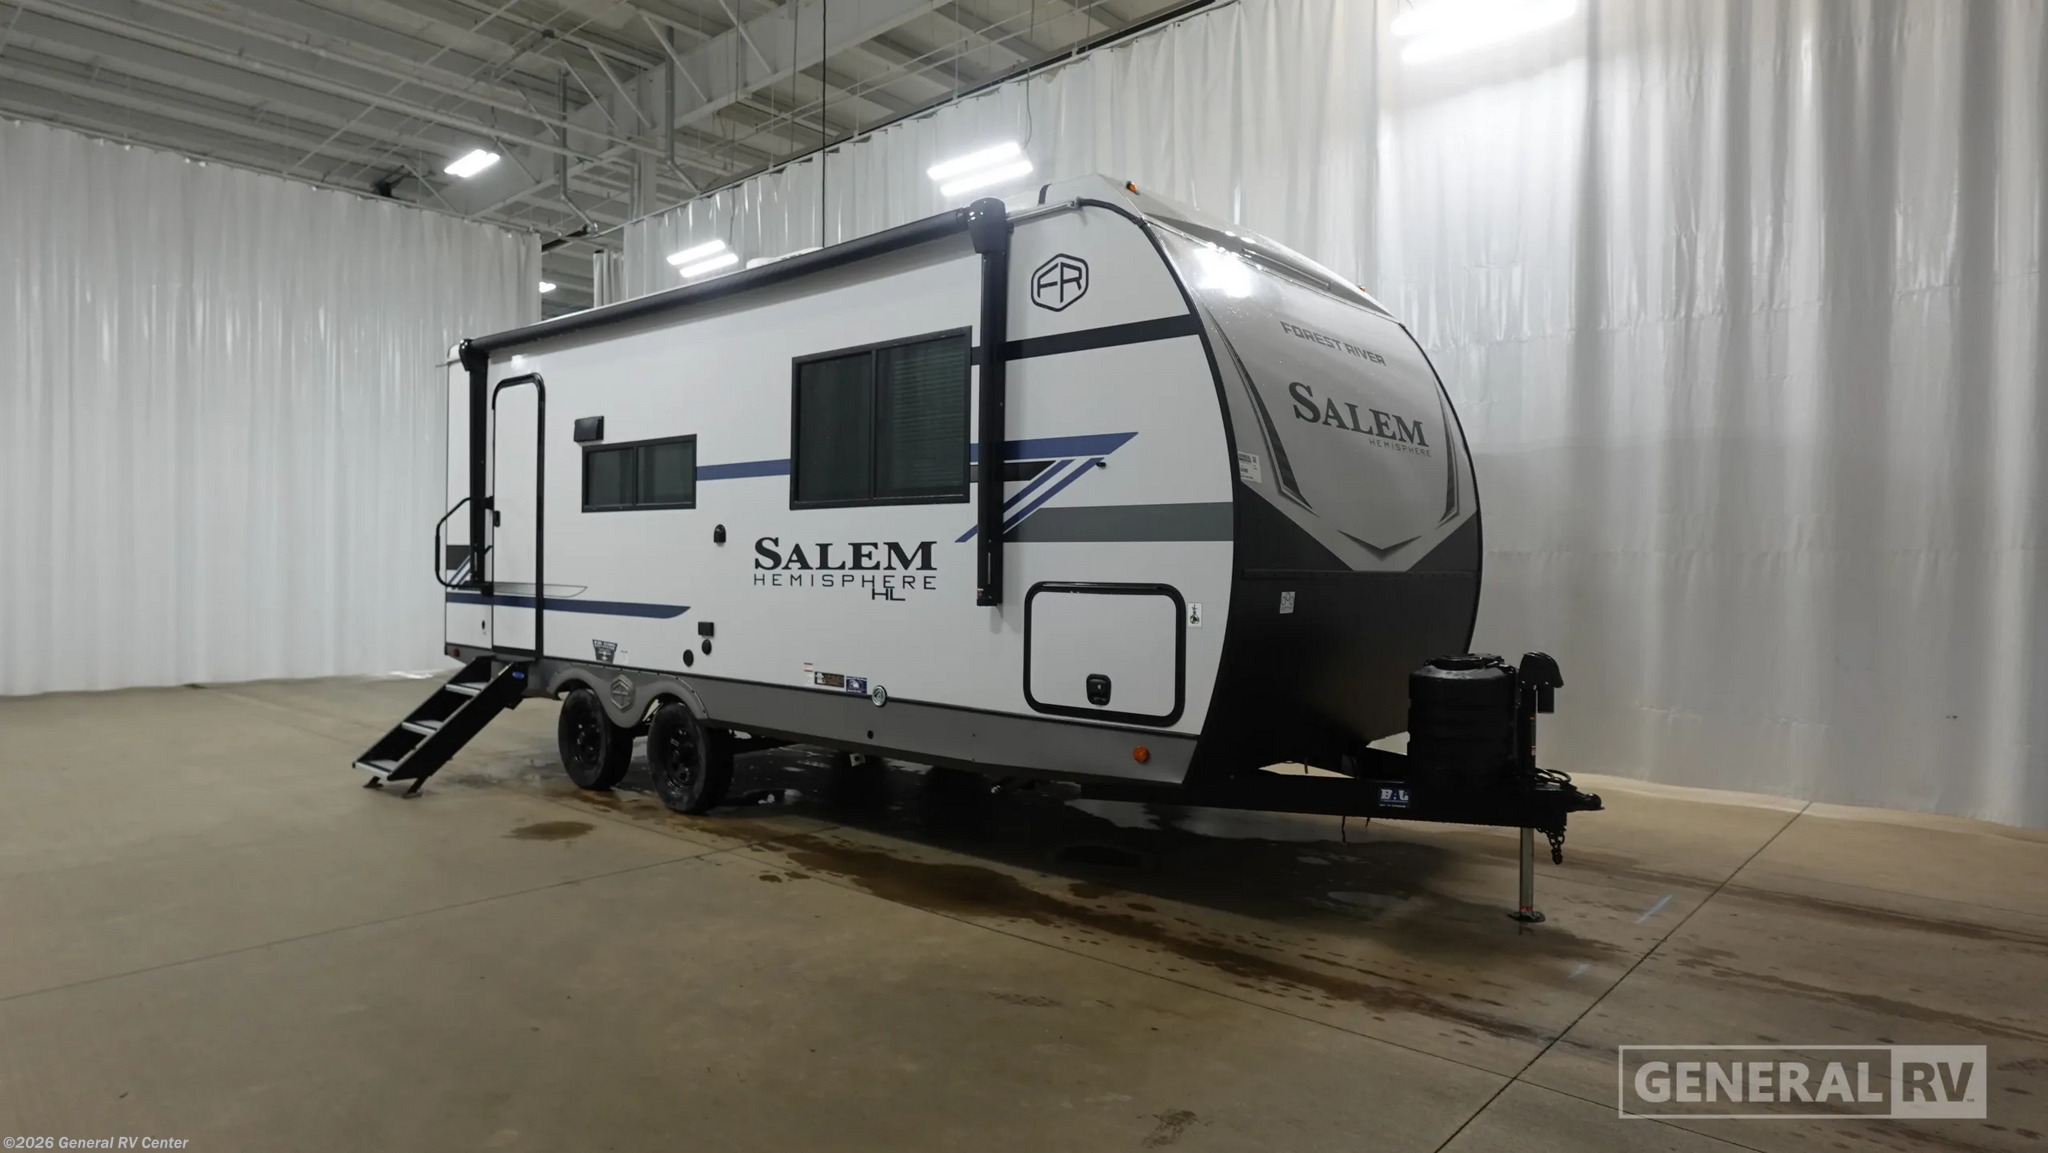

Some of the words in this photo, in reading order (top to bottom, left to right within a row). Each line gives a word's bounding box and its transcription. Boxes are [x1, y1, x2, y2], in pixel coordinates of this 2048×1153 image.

[1280, 320, 1343, 351] FOREST
[1343, 343, 1387, 367] RIVER
[1288, 381, 1430, 448] SALEM
[1369, 438, 1432, 457] HEMISPHERE
[754, 536, 938, 571] SALEM
[753, 573, 937, 590] HEMISPHERE
[871, 587, 906, 601] HL
